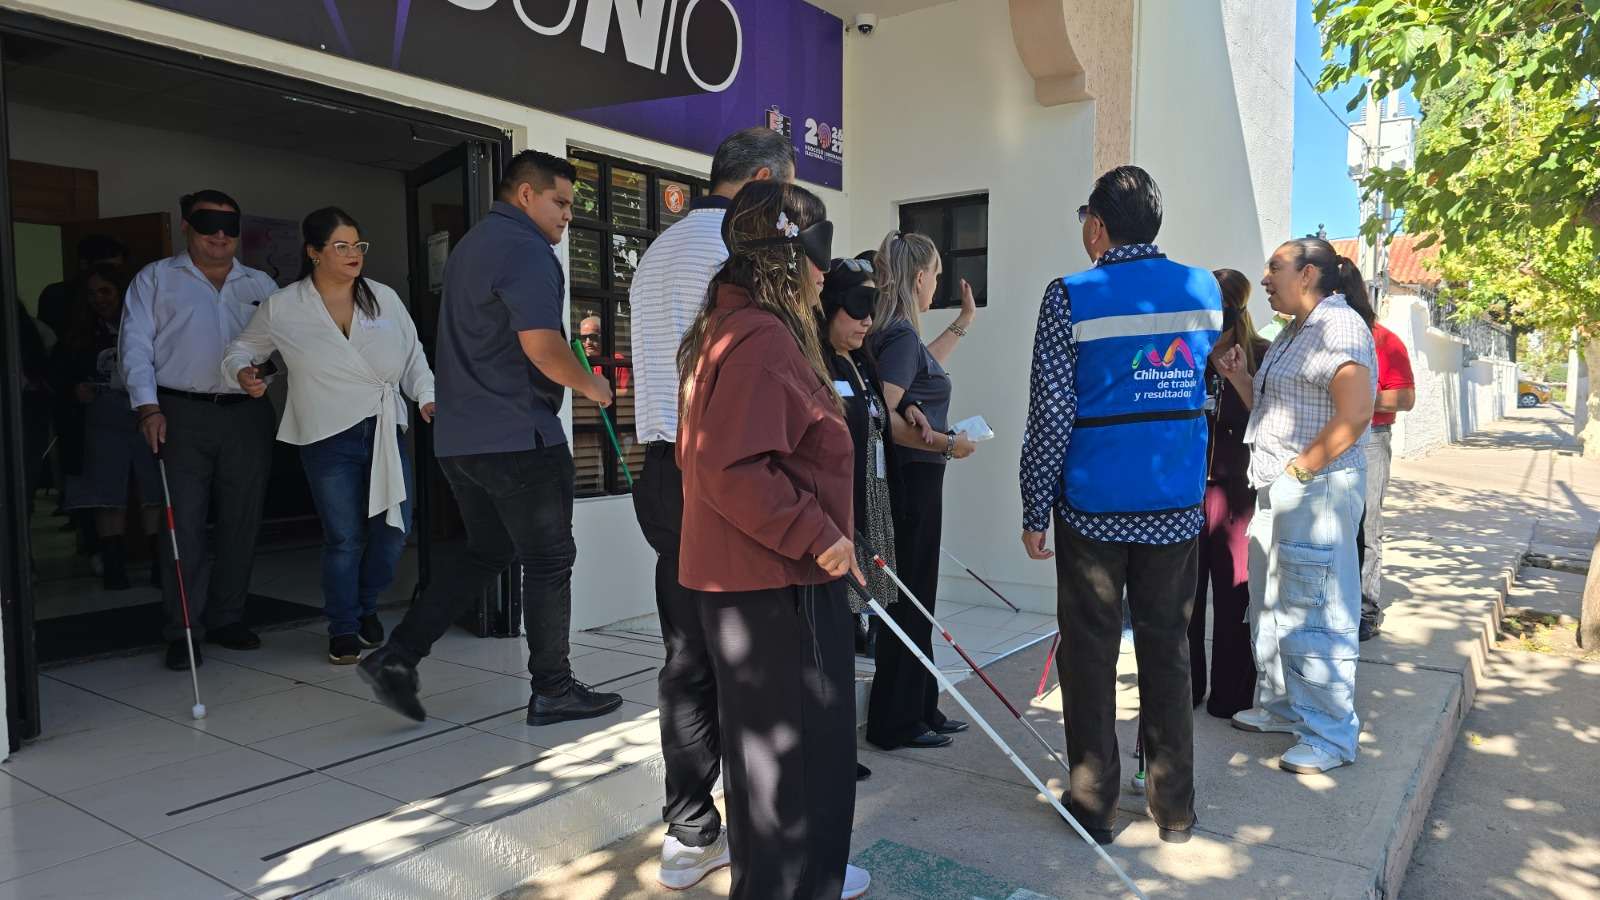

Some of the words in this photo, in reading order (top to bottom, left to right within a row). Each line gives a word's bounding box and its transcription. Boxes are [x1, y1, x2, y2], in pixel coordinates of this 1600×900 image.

[1134, 369, 1194, 380] Chihuahua
[1157, 380, 1169, 389] de
[1134, 393, 1141, 402] y
